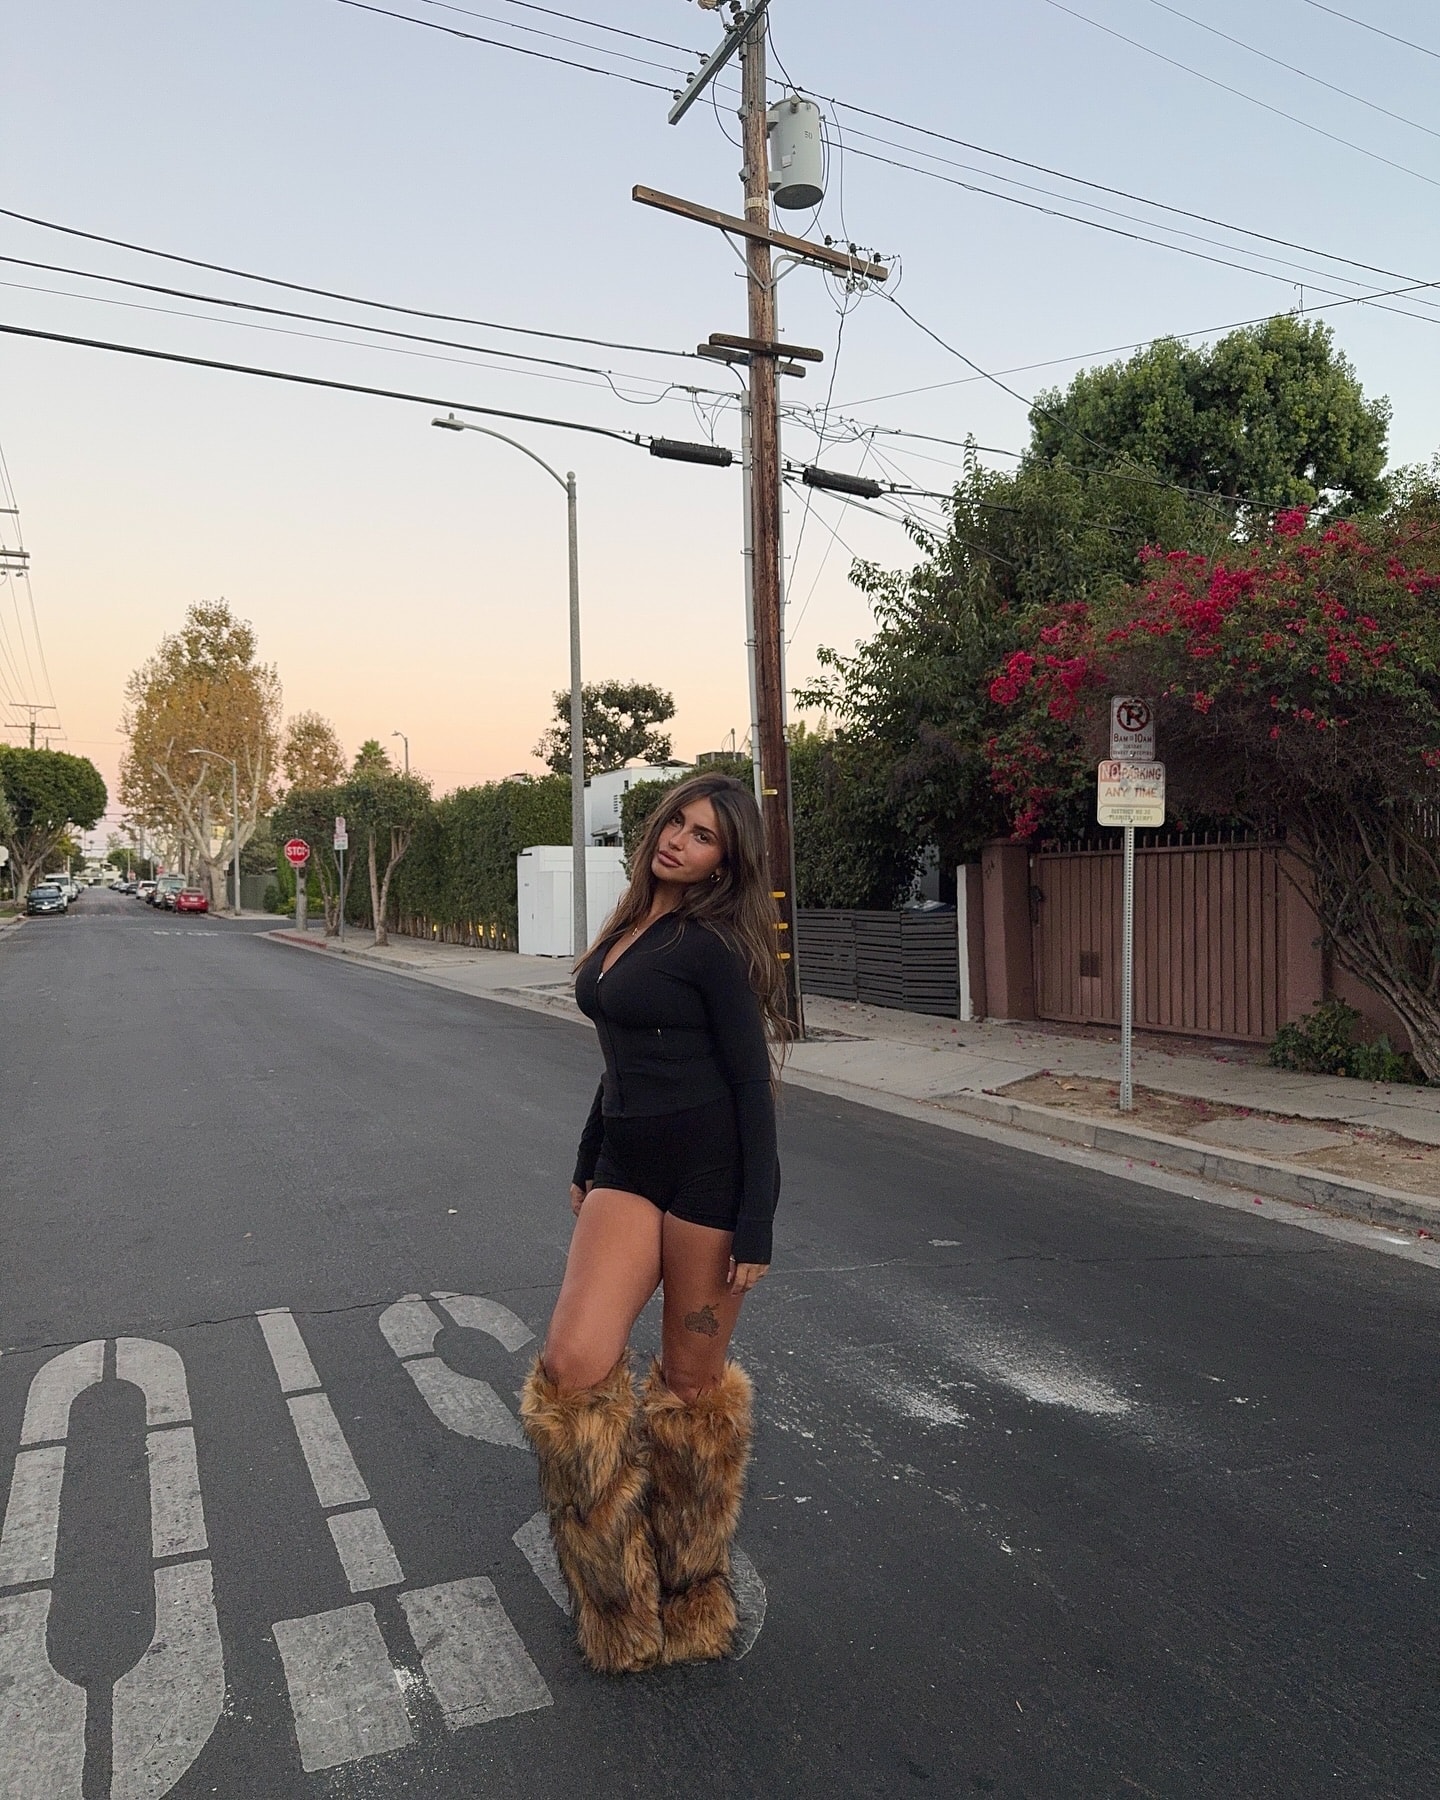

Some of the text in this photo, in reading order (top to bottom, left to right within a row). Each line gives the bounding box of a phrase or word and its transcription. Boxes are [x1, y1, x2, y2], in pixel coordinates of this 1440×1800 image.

[1102, 764, 1161, 780] NO PARKING
[1105, 787, 1157, 798] ANY TIME
